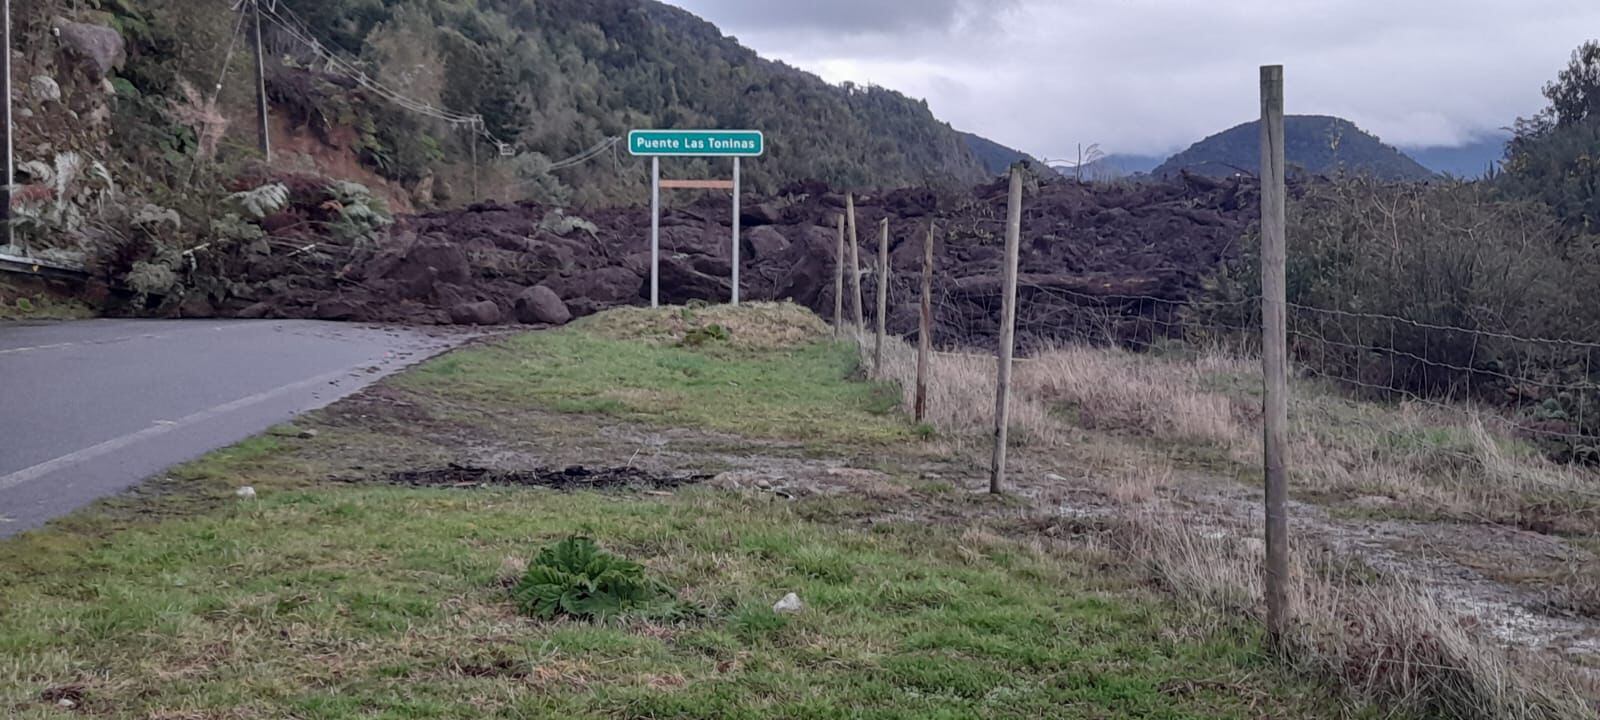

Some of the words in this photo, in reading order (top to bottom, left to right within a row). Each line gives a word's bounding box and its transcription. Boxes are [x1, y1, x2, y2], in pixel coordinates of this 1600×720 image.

[636, 137, 680, 149] Puente
[684, 137, 704, 149] Las
[708, 137, 755, 149] Toninas
